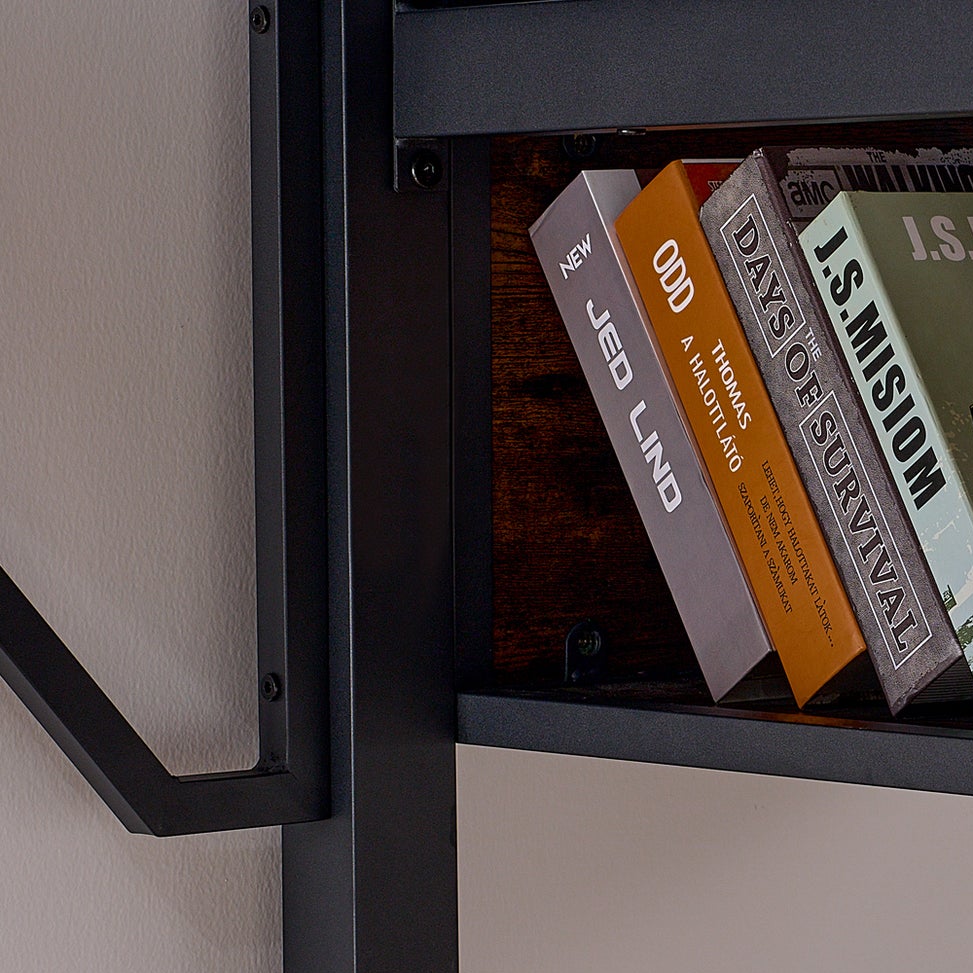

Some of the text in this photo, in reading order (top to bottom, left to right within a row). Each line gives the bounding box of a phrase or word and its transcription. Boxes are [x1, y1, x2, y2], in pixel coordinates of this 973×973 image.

[866, 151, 887, 163] THE
[558, 232, 593, 280] NEW
[653, 239, 695, 313] ODD
[680, 335, 694, 352] A
[805, 327, 823, 362] THE
[813, 226, 947, 511] J.S.MISIOM
[586, 299, 683, 513] JED LIND
[711, 338, 752, 430] THOMAS
[732, 213, 918, 653] DAYS OF SURVIVAL
[760, 495, 798, 585] DE NEM AKAROM
[775, 496, 793, 527] HOGY
